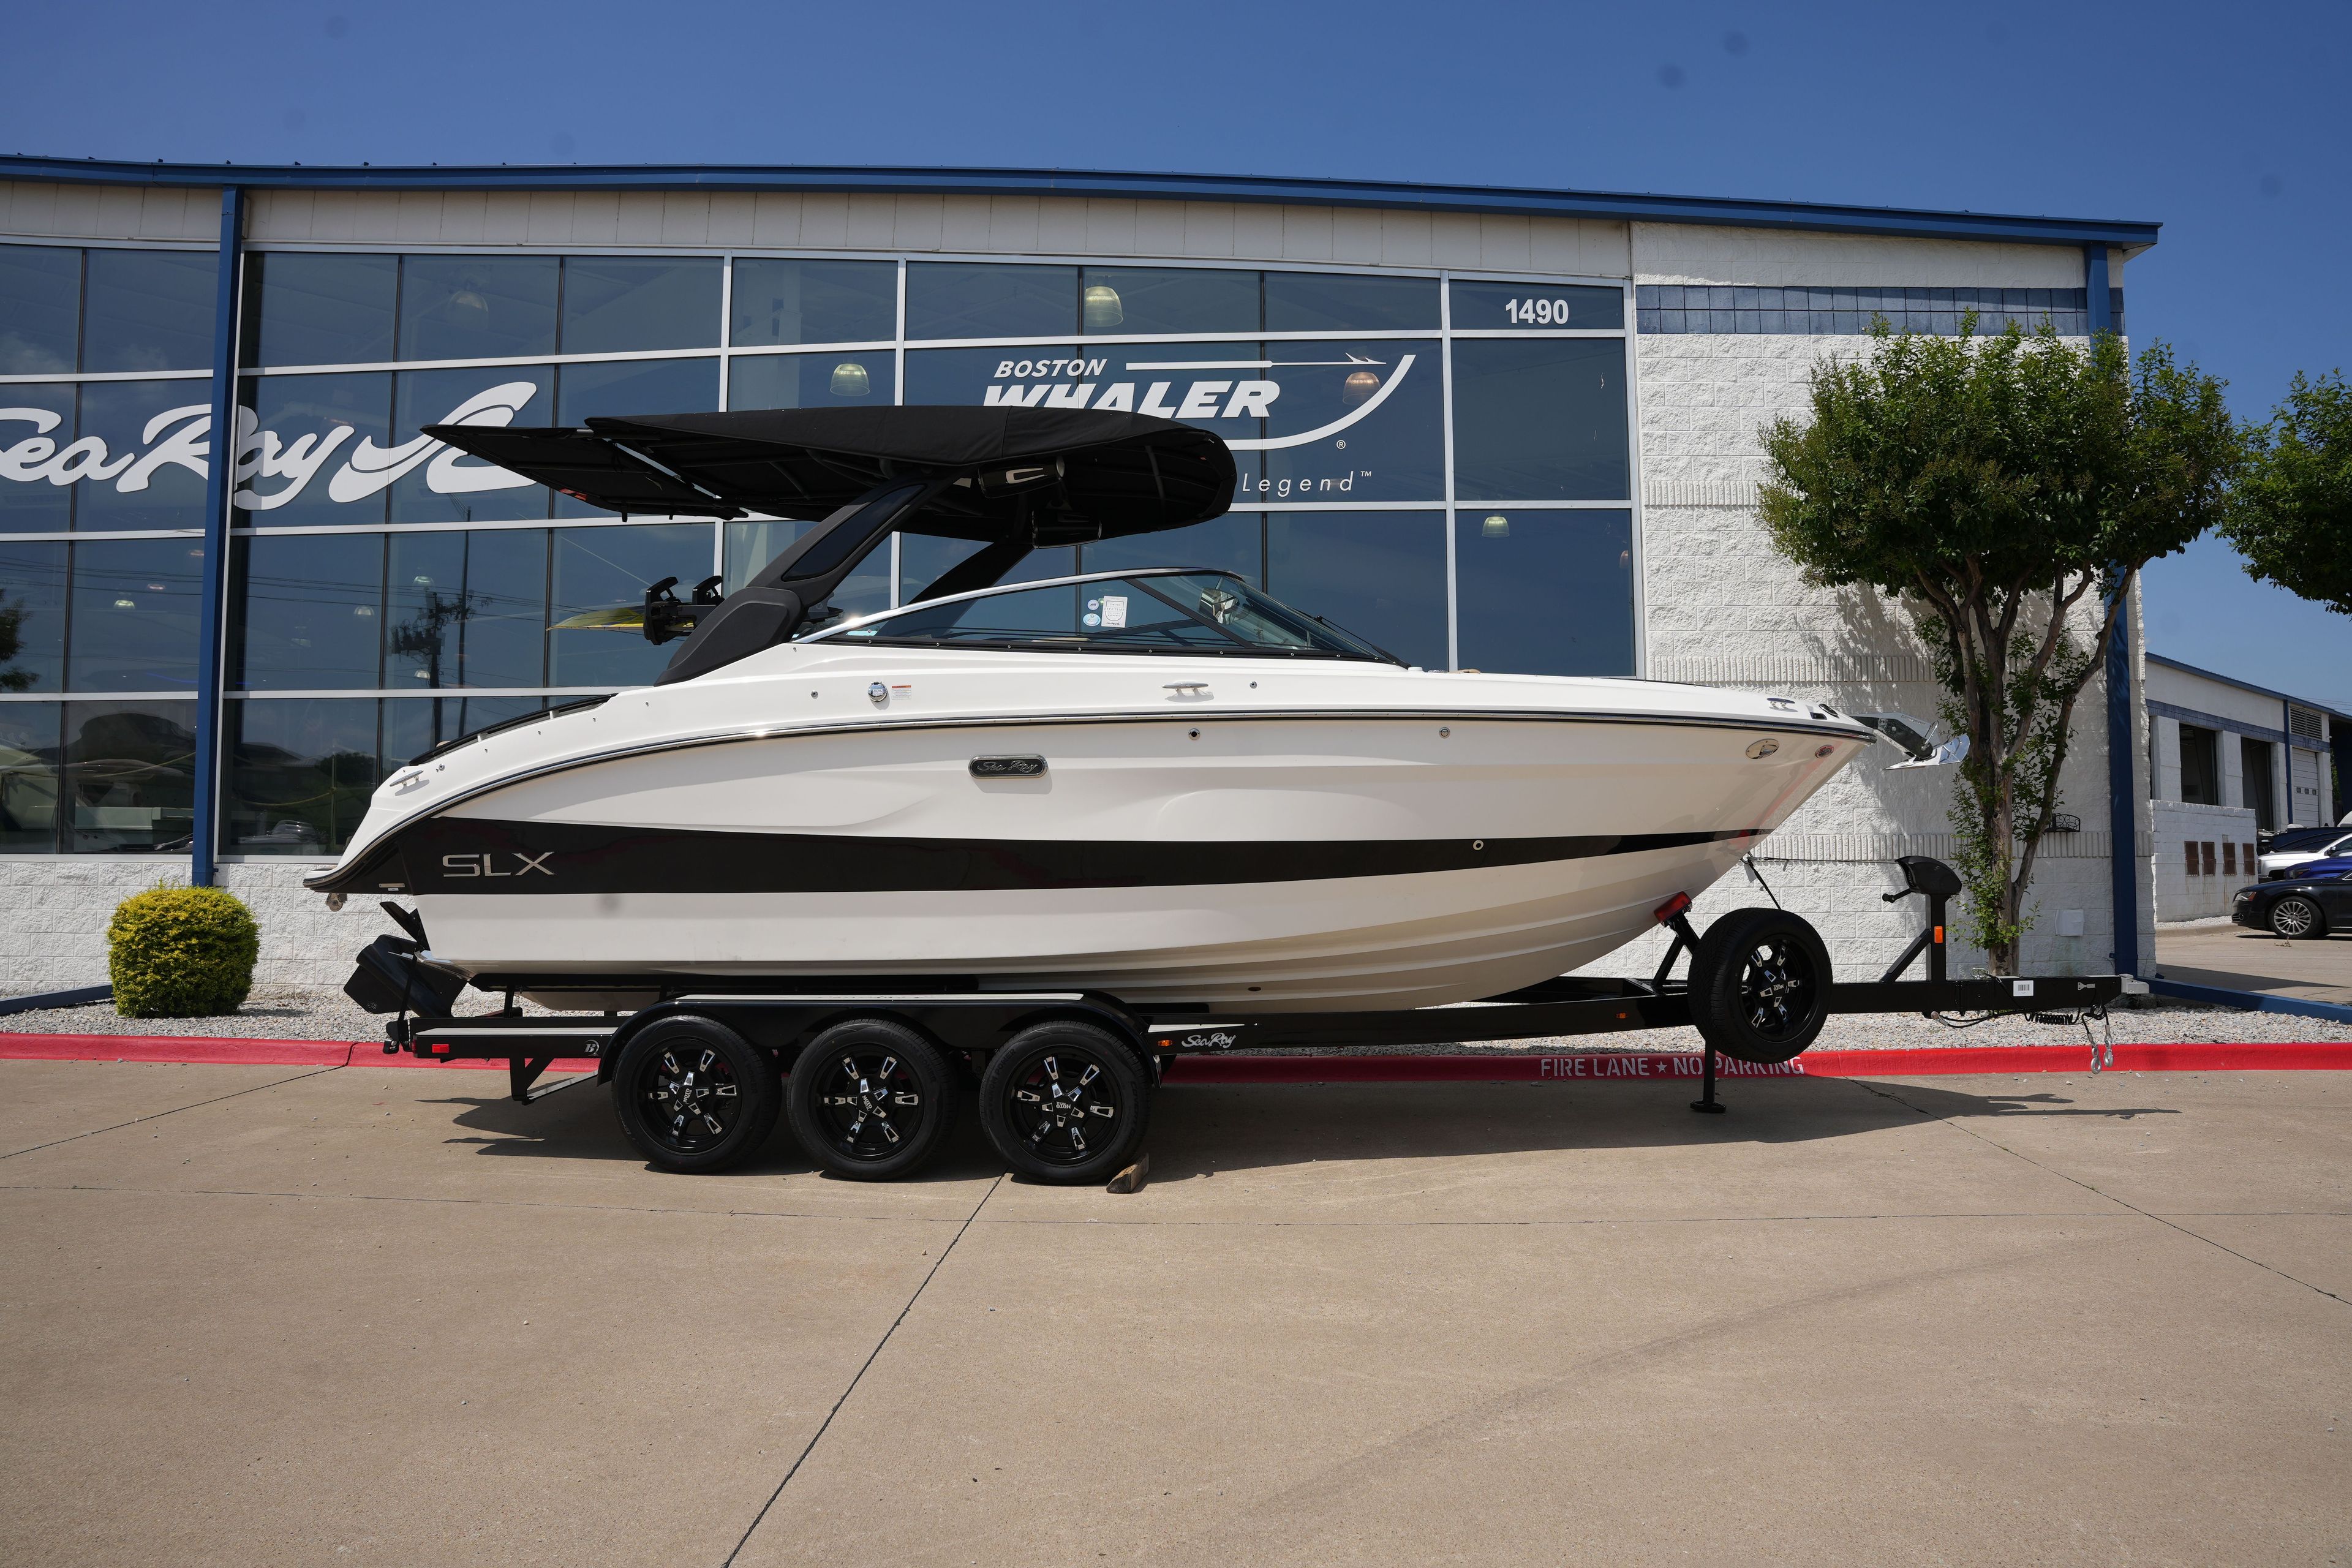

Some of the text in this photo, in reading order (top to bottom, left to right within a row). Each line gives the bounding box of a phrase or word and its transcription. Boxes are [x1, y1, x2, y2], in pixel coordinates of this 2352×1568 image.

[1506, 299, 1569, 324] 1490
[993, 358, 1107, 378] BOSTON
[983, 380, 1280, 418] WHALER
[116, 403, 355, 510] Ray
[1242, 470, 1354, 497] Legend
[977, 760, 1038, 773] Sea Ray
[442, 851, 556, 877] SLX
[1182, 1033, 1237, 1049] Sea Ray
[1540, 1058, 1586, 1076] FIRE
[1593, 1058, 1650, 1076] LANE
[1673, 1057, 1703, 1075] NO
